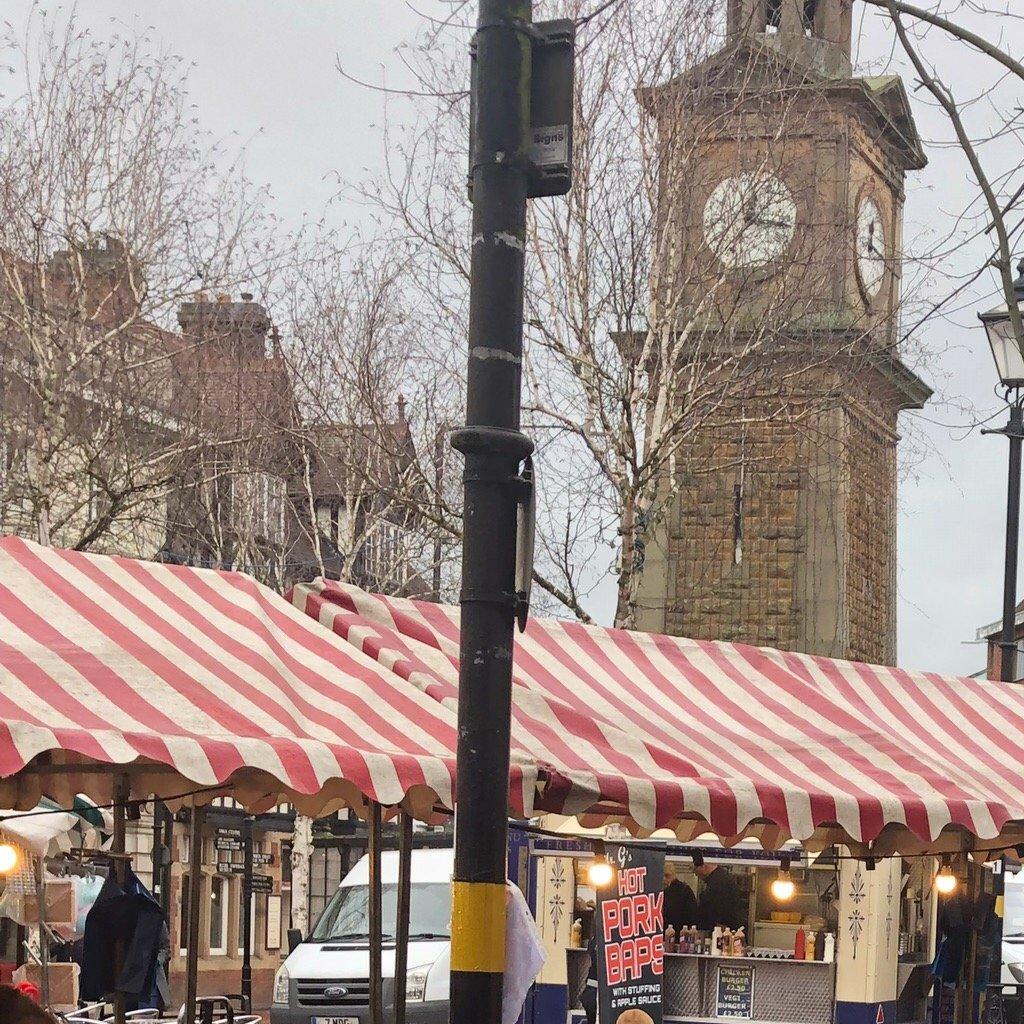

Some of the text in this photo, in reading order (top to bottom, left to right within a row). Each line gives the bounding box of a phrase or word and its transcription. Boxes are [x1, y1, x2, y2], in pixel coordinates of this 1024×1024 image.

[617, 866, 647, 897] HOT
[601, 891, 664, 943] PORK
[604, 933, 664, 986] BAPS
[612, 983, 660, 997] WITH STUFFING
[617, 997, 637, 1007] APPLE
[637, 994, 662, 1006] SAUCE
